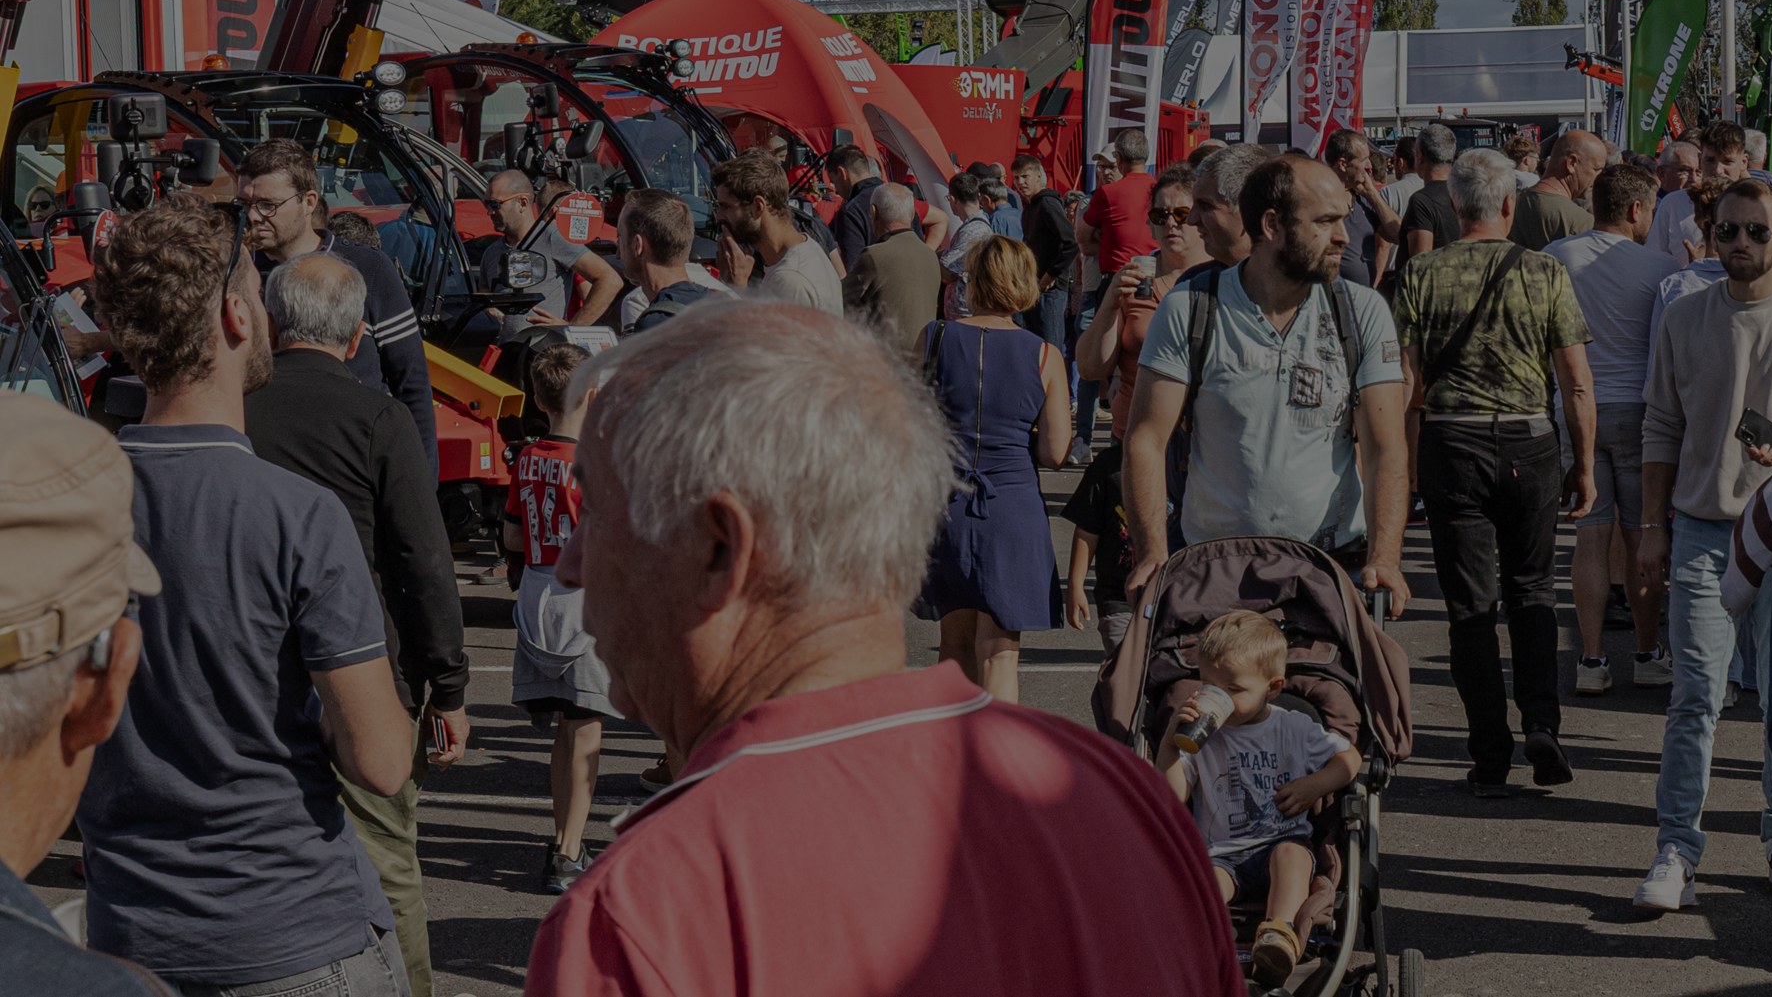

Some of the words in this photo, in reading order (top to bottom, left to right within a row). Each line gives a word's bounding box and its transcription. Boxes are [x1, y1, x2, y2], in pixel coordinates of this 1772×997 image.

[618, 25, 783, 56] BOTIQUE
[1649, 22, 1692, 111] KRONE
[520, 484, 572, 565] 14
[1239, 750, 1278, 771] MAKE
